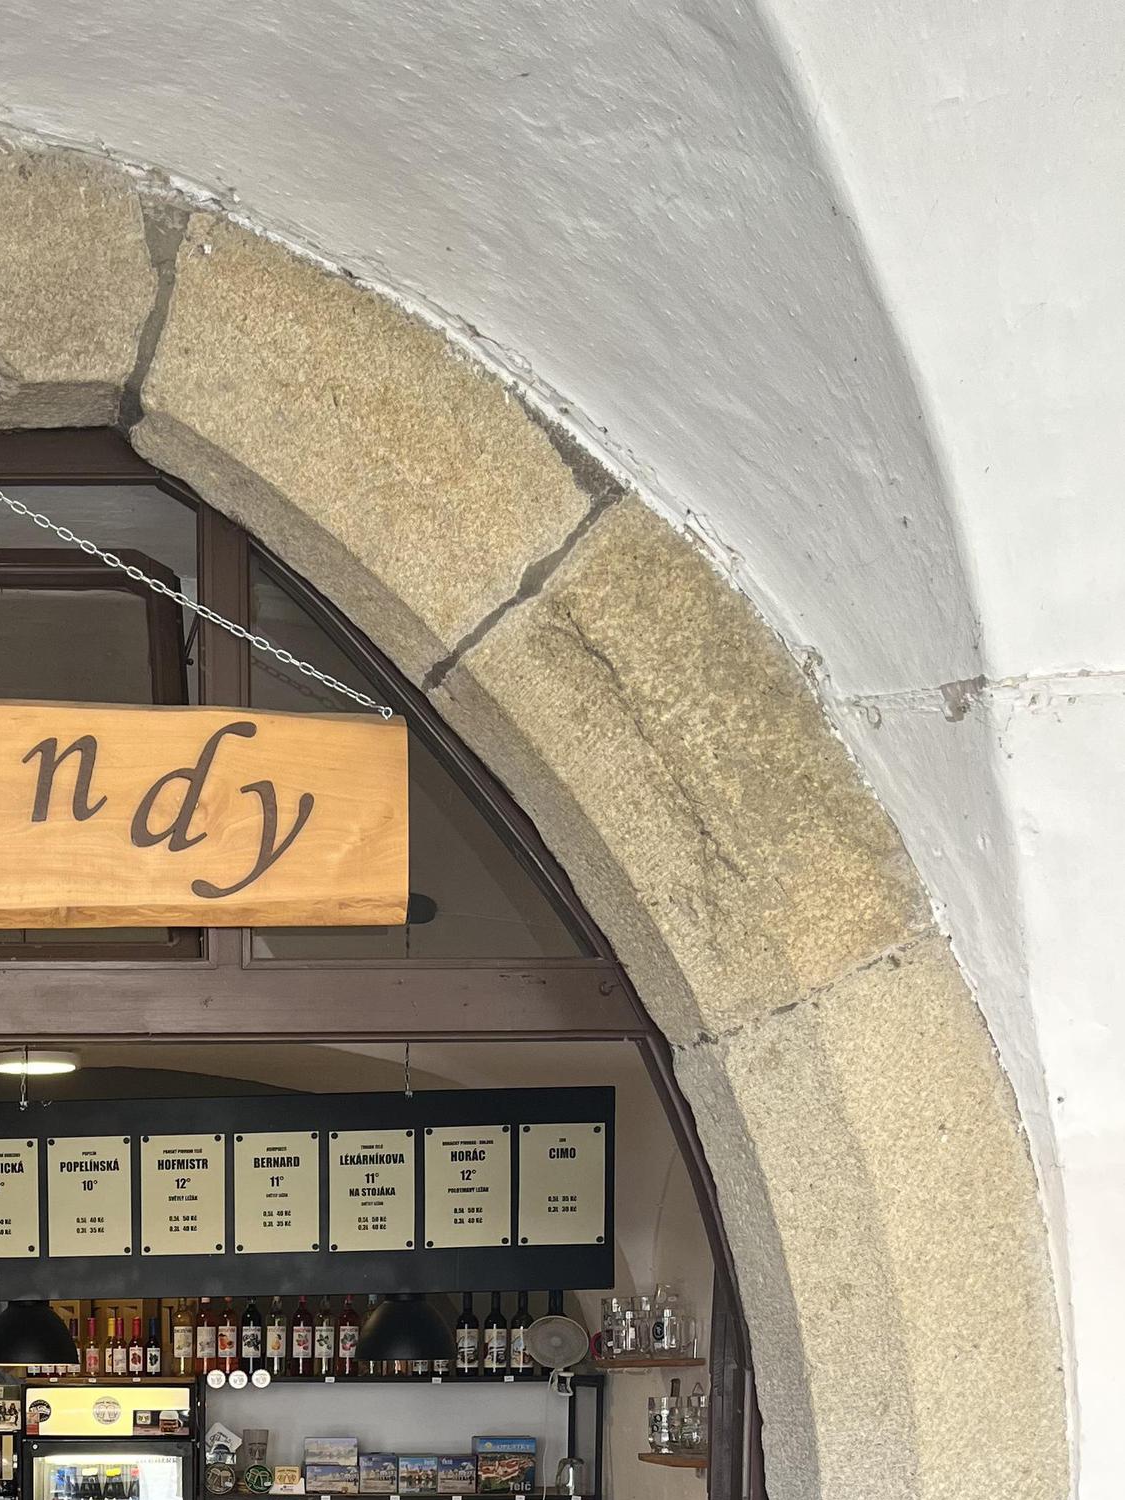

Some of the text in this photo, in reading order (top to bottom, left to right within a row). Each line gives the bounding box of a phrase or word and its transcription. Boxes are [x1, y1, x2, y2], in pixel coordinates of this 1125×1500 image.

[339, 1152, 405, 1165] LÉKÁRNÍKOVA
[451, 1148, 485, 1162] HORÁC
[549, 1148, 576, 1159] CIMO
[59, 1158, 119, 1172] POPELÍNSKÁ
[157, 1159, 209, 1170] HOFMISTR
[253, 1156, 300, 1168] BERNARD
[365, 1172, 379, 1184] 11°
[460, 1170, 477, 1181] 12°
[82, 1180, 98, 1191] 10°
[175, 1178, 191, 1189] 12°
[270, 1176, 285, 1187] 11°
[349, 1186, 395, 1197] NA STOJÁKA
[509, 1482, 531, 1491] Telč
